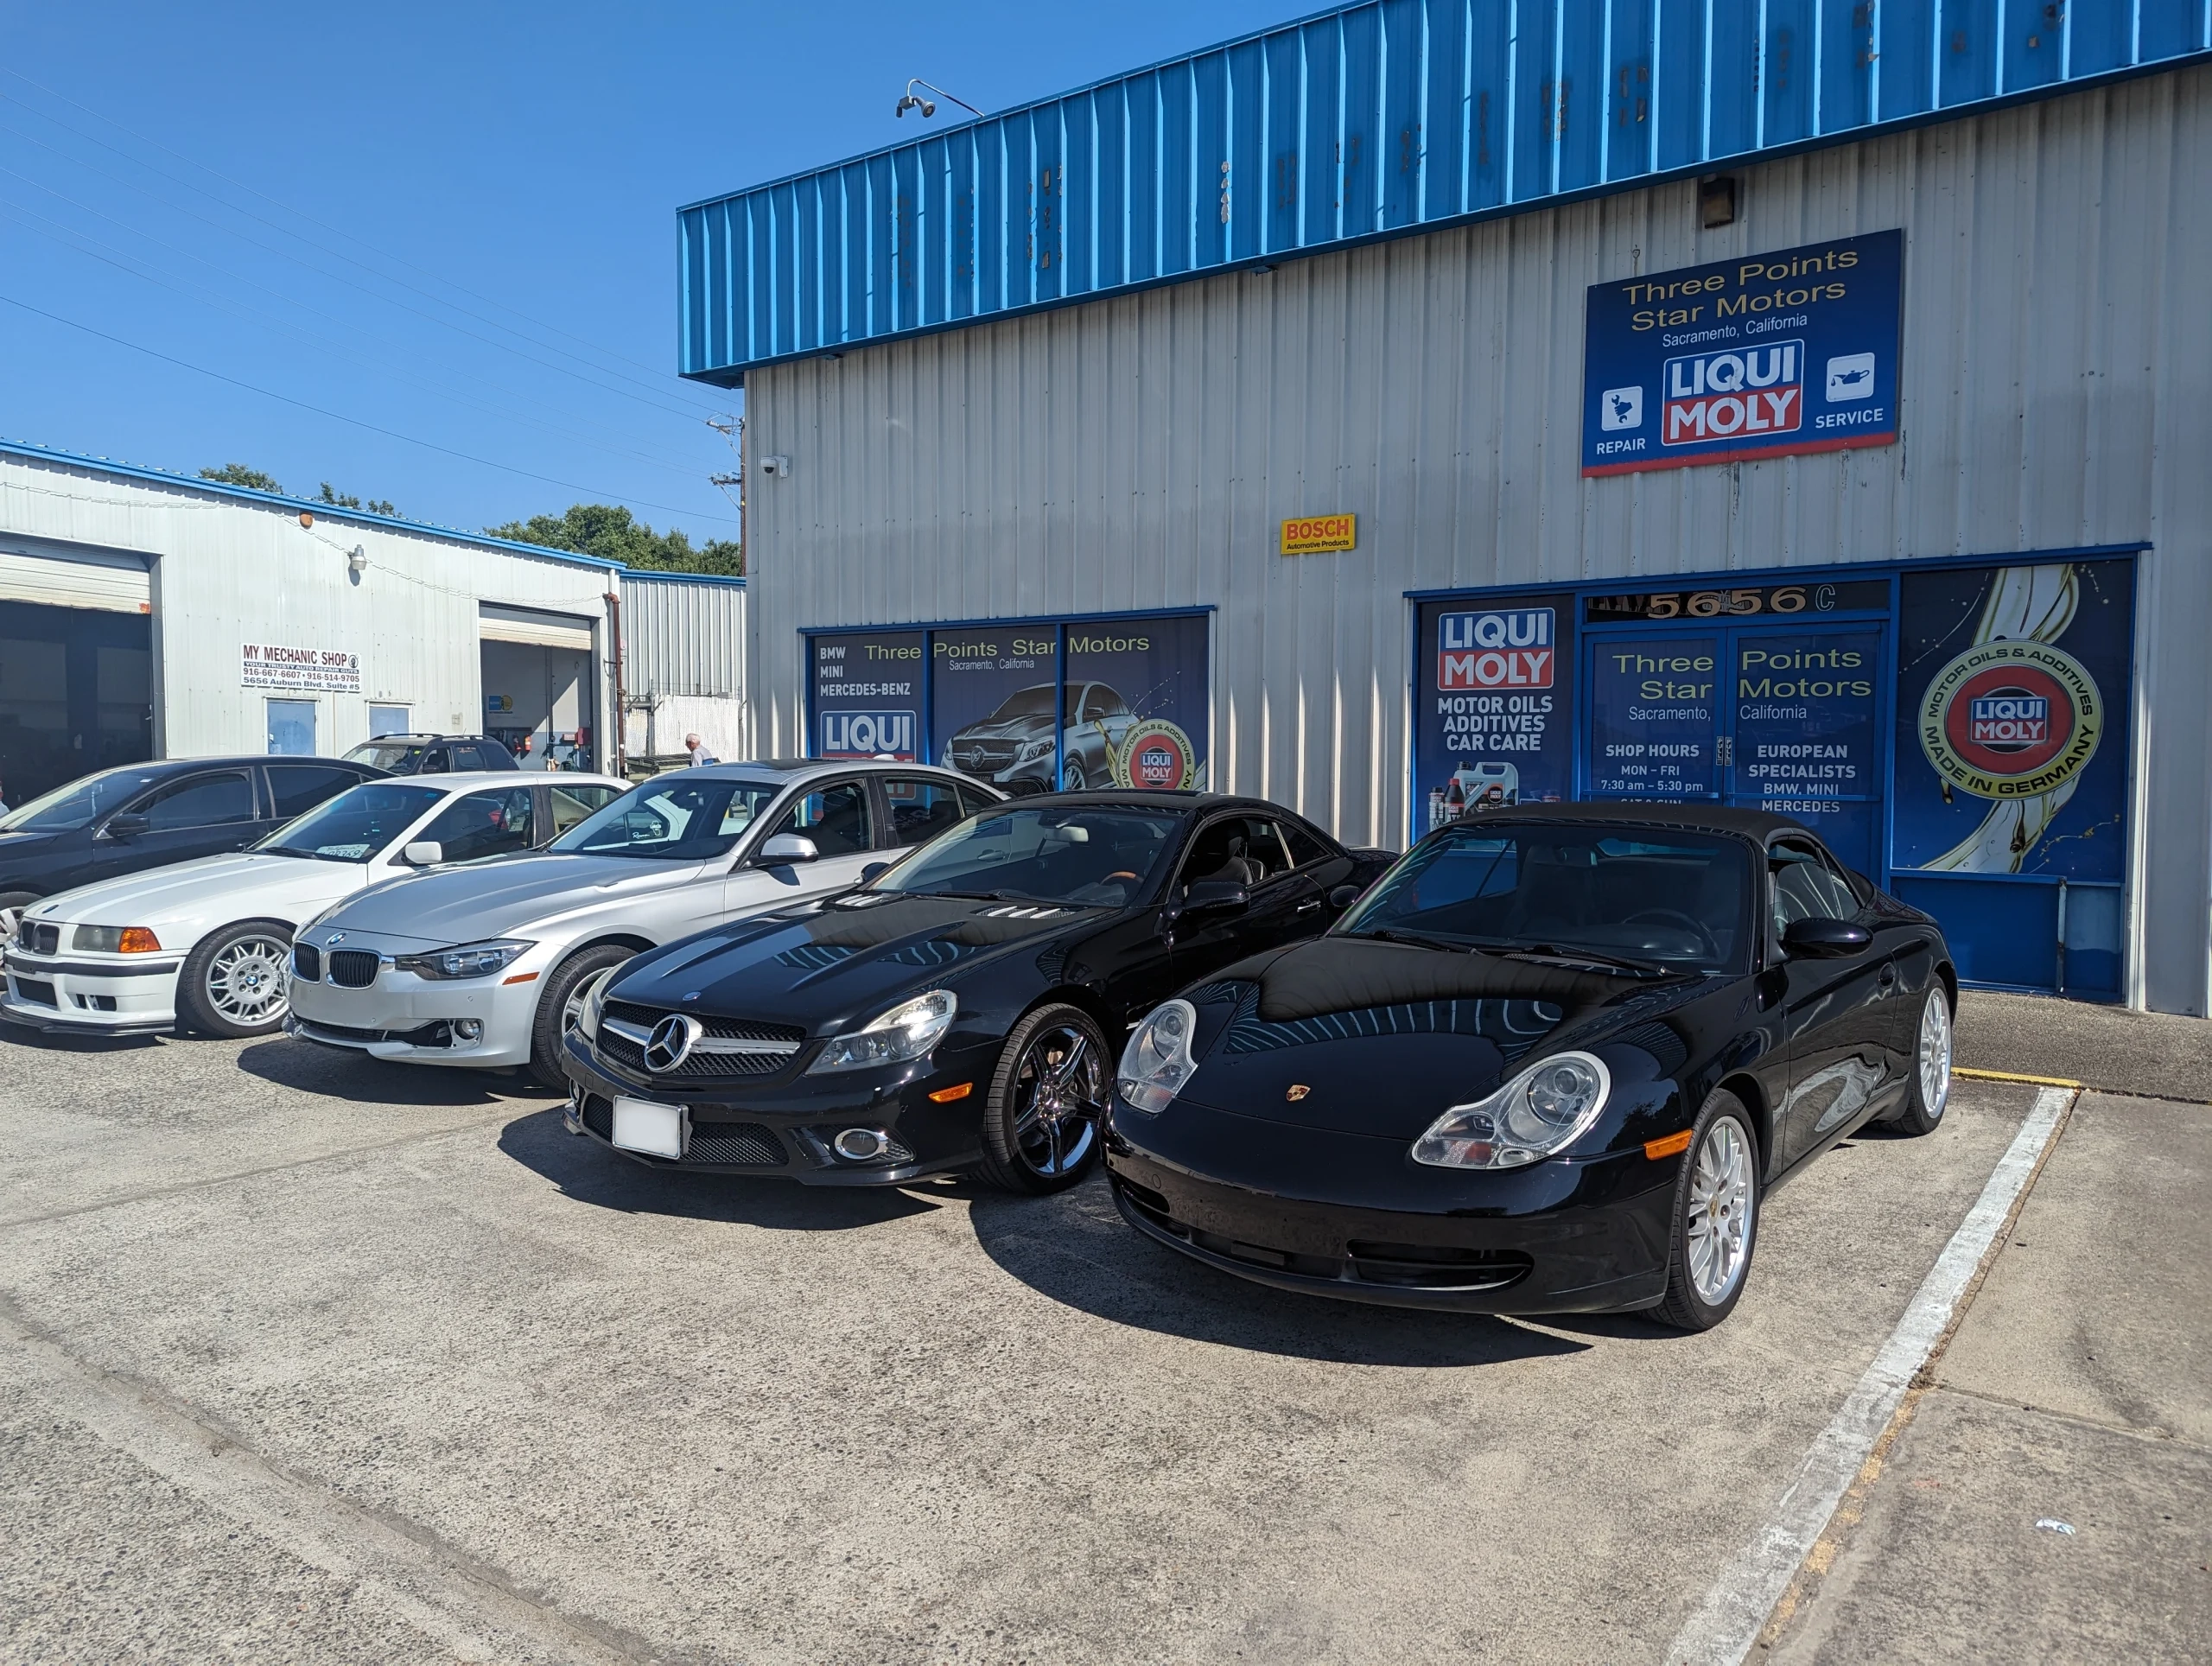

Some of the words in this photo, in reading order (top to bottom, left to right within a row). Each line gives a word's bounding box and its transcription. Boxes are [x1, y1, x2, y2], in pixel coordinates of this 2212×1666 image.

[1622, 275, 1726, 305] Three
[1738, 250, 1859, 286] Points
[1631, 305, 1705, 331] Star
[1717, 283, 1847, 318] Motors
[1662, 324, 1740, 347] Sacramento,
[1745, 313, 1808, 334] California
[1671, 346, 1796, 398] LIQUI
[1670, 389, 1799, 440] MOLY
[1815, 408, 1884, 429] SERVICE
[1597, 438, 1646, 455] REPAIR
[1287, 518, 1350, 540] BOSCH
[1648, 587, 1808, 619] 5656
[1446, 614, 1548, 649] LIQUI
[244, 645, 259, 659] MY
[264, 646, 317, 664] MECHANIC
[321, 652, 347, 666] SHOP
[820, 646, 846, 659] BMW
[864, 645, 922, 660] Three
[933, 641, 998, 658] Points
[1012, 639, 1057, 656] Star
[1069, 637, 1150, 653] Motors
[949, 660, 995, 671] Sacramento,
[999, 658, 1034, 669] California
[1445, 652, 1551, 685] MOLY
[1612, 654, 1714, 673] Three
[1742, 649, 1862, 670] Points
[243, 667, 301, 678] 916-667-6607
[307, 672, 360, 682] 916-514-9705
[820, 665, 843, 677] MINI
[820, 683, 911, 696] MERCEDES-BENZ
[1640, 680, 1713, 700] Star
[1739, 677, 1872, 698] Motors
[1929, 663, 1969, 718] MOTOR
[1967, 648, 2008, 668] OILS
[2011, 648, 2026, 658] &
[2028, 650, 2094, 716] ADDITIVES
[1438, 696, 1503, 714] MOTOR
[1508, 696, 1554, 713] OILS
[1629, 707, 1711, 722] Sacramento,
[1739, 704, 1808, 720] California
[1975, 701, 2043, 720] LIQUI
[1443, 715, 1546, 732] ADDITIVES
[1975, 722, 2044, 740] MOLY
[826, 715, 910, 753] LIQUI
[1446, 734, 1485, 751] CAR
[1489, 734, 1541, 751] CARE
[1122, 732, 1140, 764] MOTOR
[1140, 724, 1156, 734] OILS
[1164, 725, 1192, 765] ADDITIVES
[1605, 745, 1644, 757] SHOP
[1649, 745, 1700, 757] HOURS
[1758, 745, 1847, 758] EUROPEAN
[1142, 755, 1171, 766] LIQUI
[1925, 726, 1968, 782] MADE
[1968, 775, 1992, 792] IN
[1998, 724, 2094, 794] GERMANY
[1142, 767, 1172, 778] MOLY
[1621, 766, 1647, 775] MON
[1661, 766, 1680, 776] FRI
[1748, 765, 1856, 779] SPECIALISTS
[1601, 779, 1624, 790] 7:30
[1657, 780, 1682, 791] 5:30
[1685, 783, 1703, 792] pm
[1807, 784, 1839, 795] MINI
[1762, 800, 1840, 812] MERCEDES
